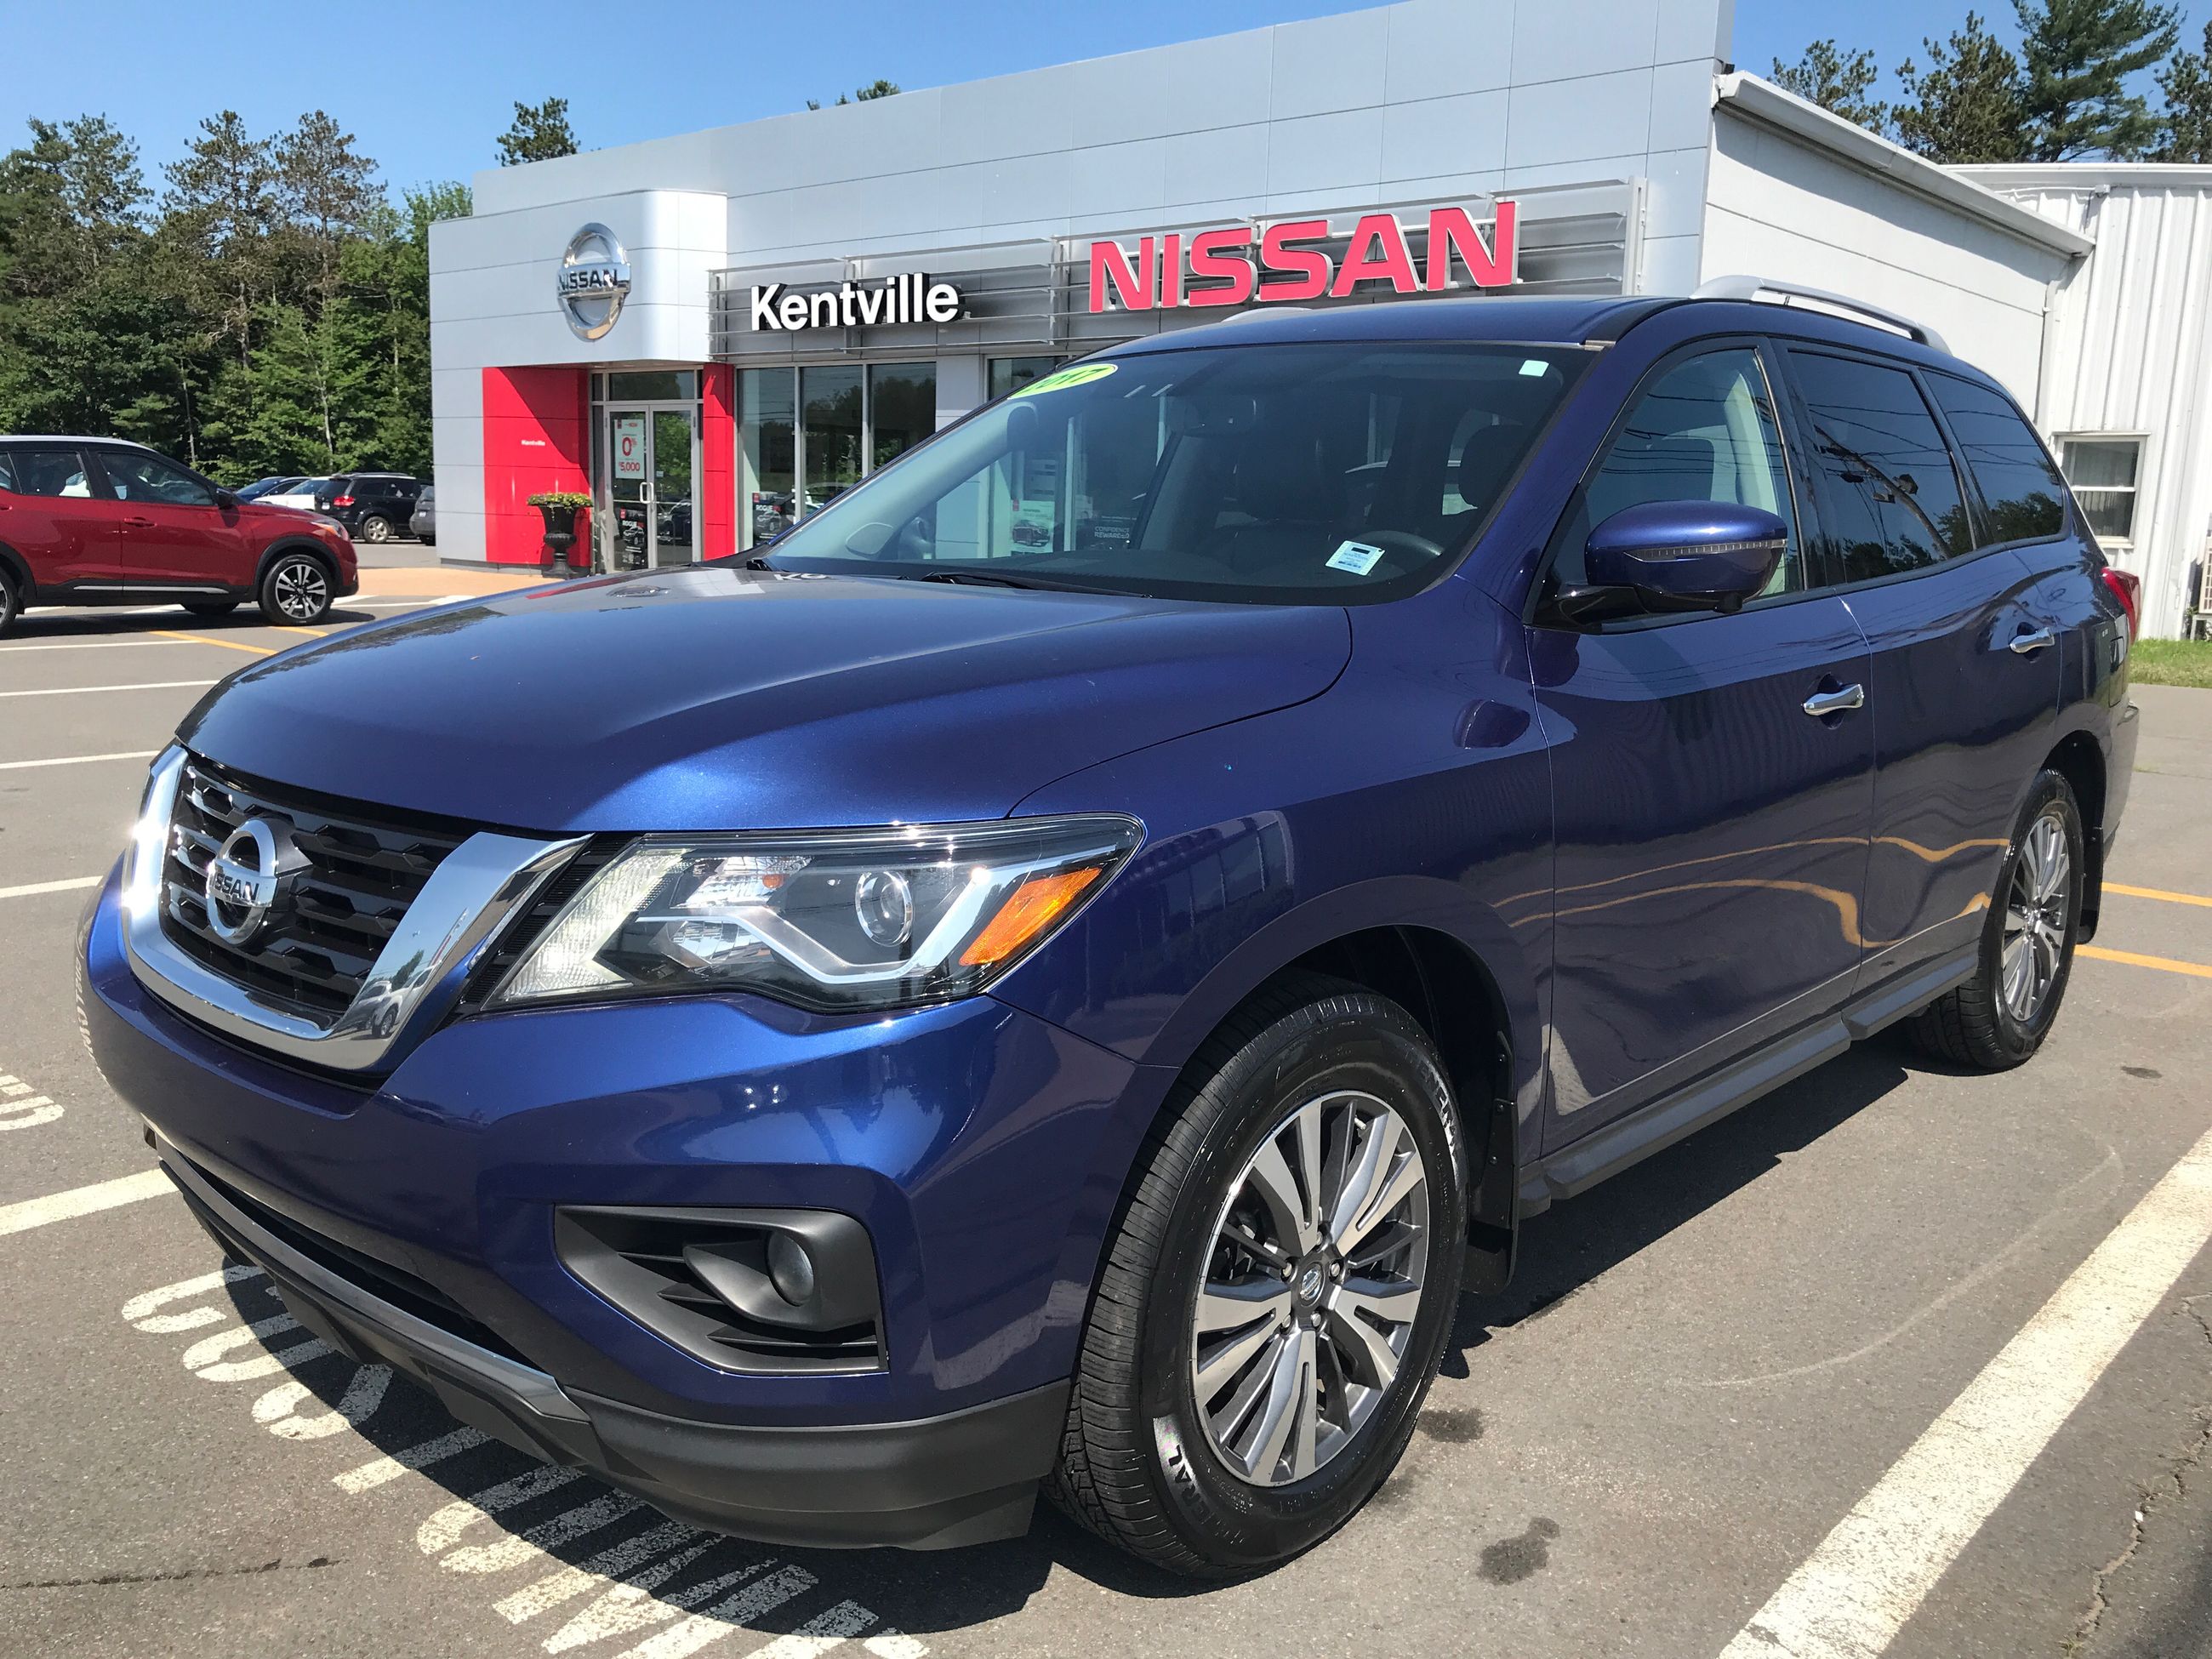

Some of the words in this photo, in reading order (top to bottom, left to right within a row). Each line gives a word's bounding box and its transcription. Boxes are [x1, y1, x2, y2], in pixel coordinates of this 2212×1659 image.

[557, 269, 619, 291] NISSAN
[1089, 201, 1520, 313] NISSAN
[751, 272, 959, 331] Kentville
